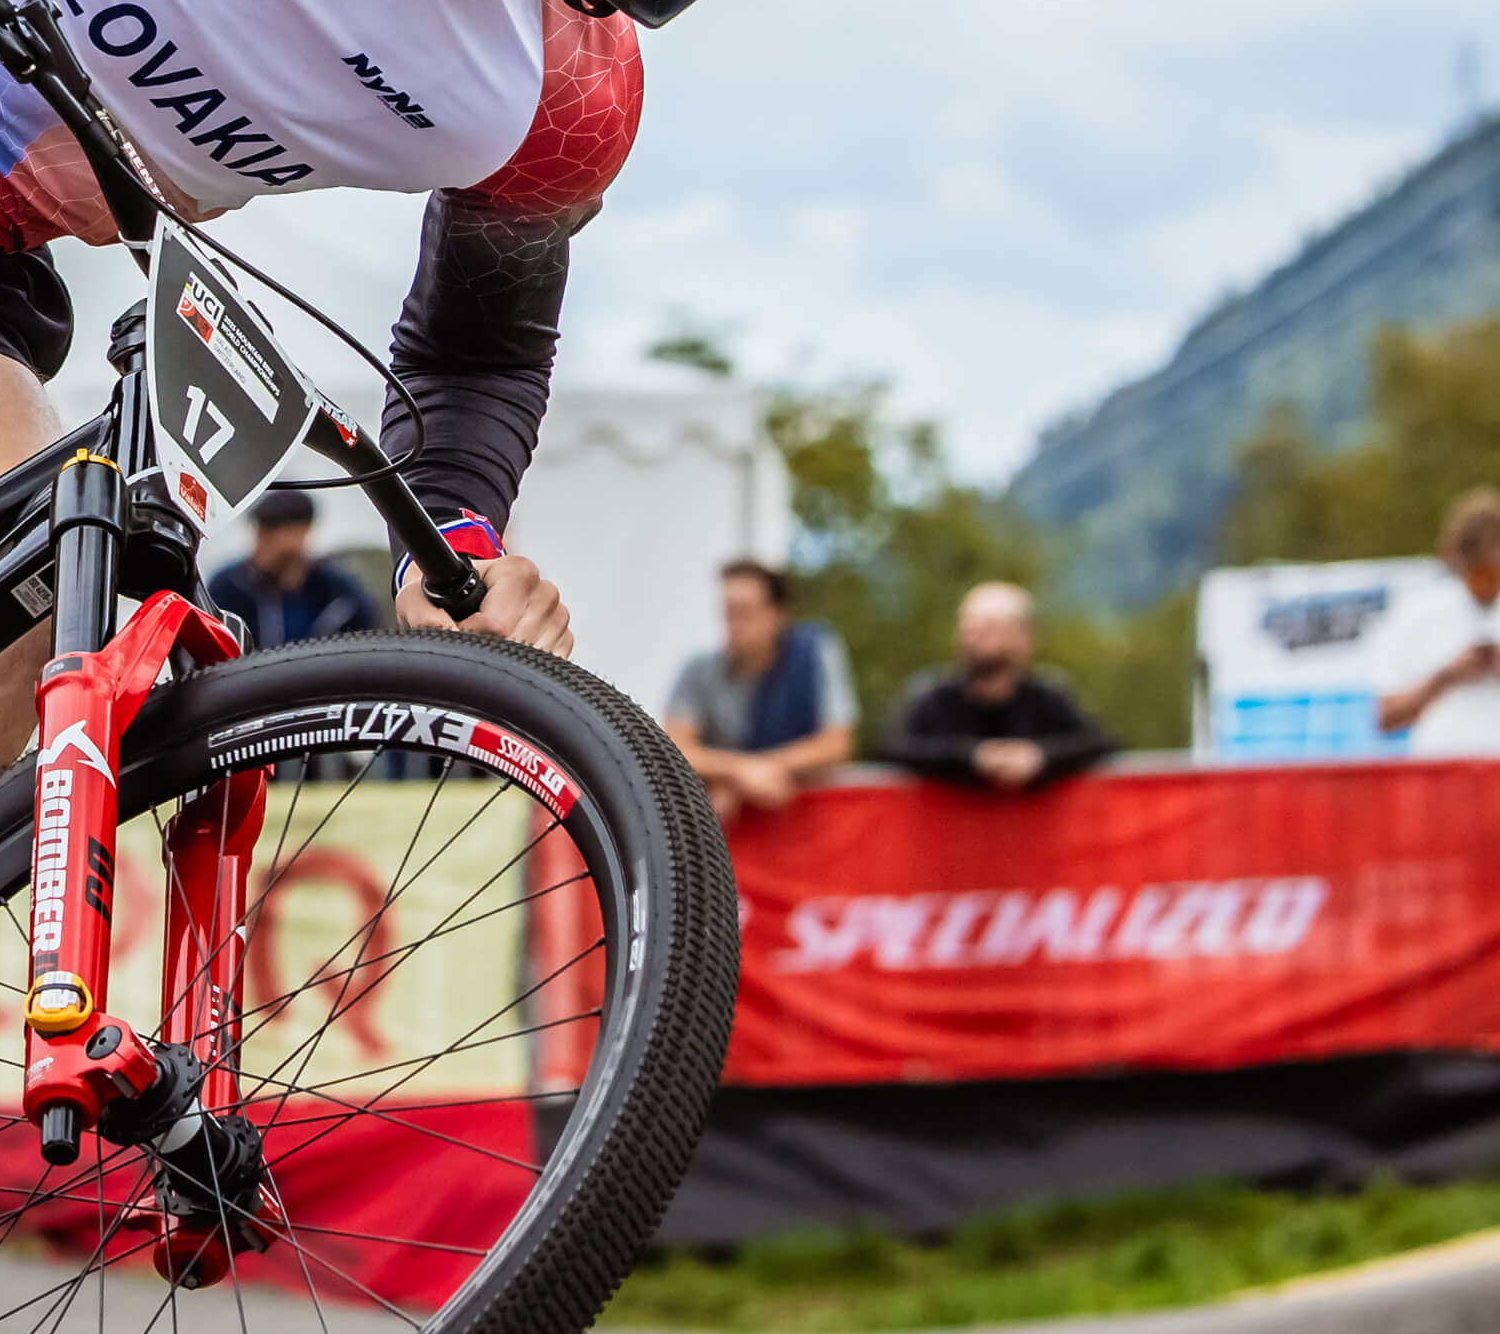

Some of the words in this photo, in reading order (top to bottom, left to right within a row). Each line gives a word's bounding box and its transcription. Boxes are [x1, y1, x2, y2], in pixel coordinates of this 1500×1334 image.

[192, 282, 221, 321] UCI
[182, 384, 236, 466] 17
[496, 734, 545, 776] SWISS
[538, 766, 567, 798] DT
[32, 769, 74, 957] BOMBER
[776, 876, 1330, 974] SPECIALIZED
